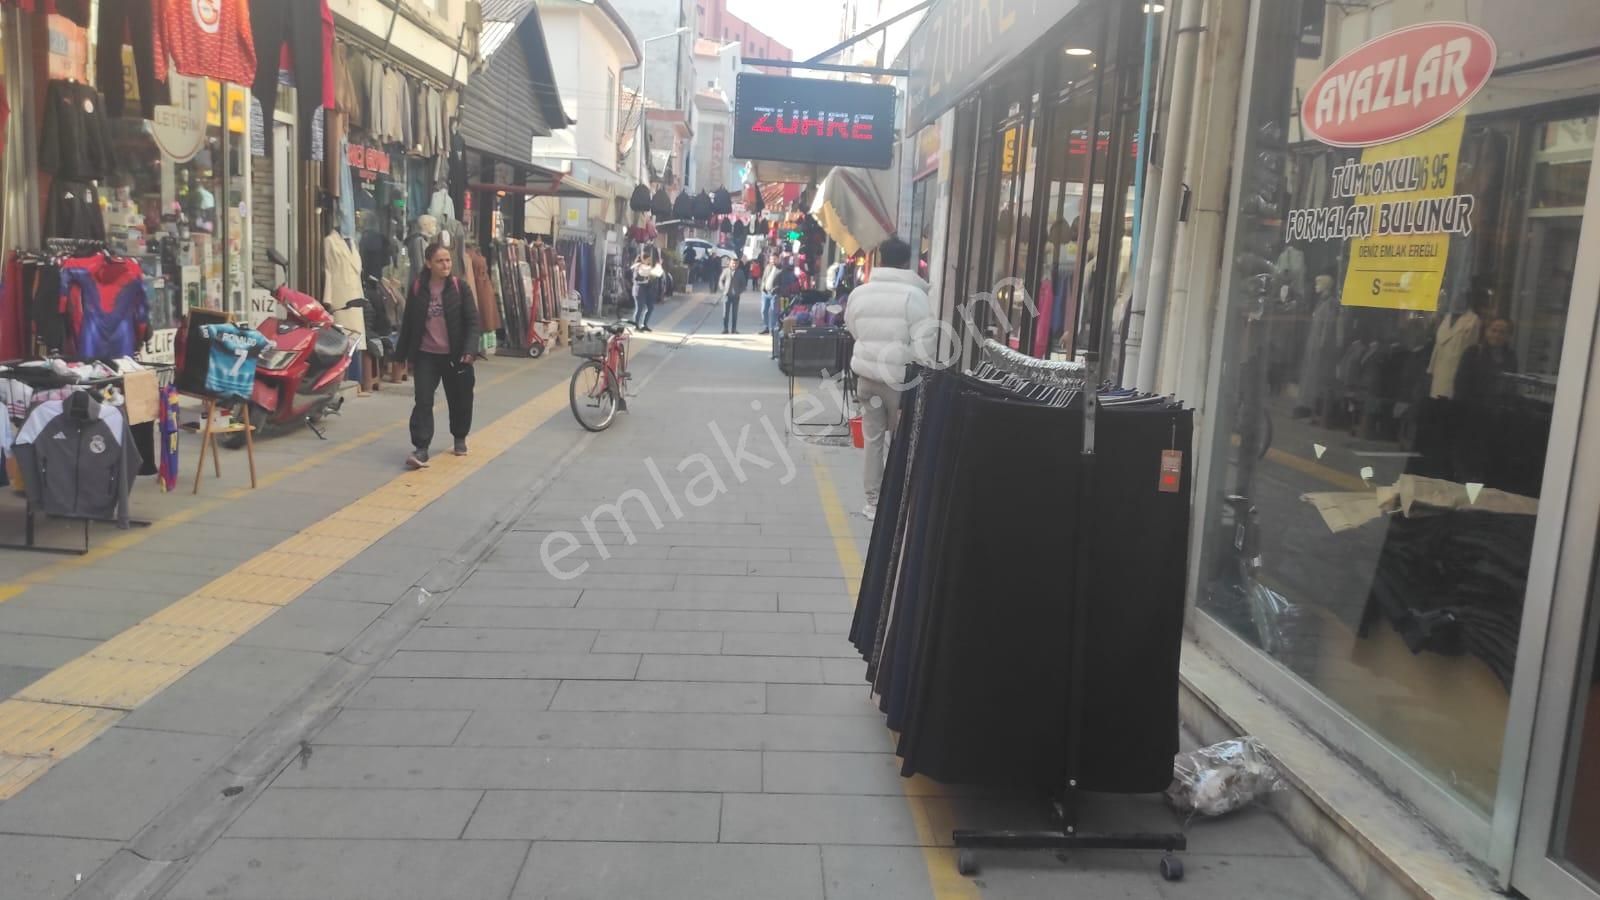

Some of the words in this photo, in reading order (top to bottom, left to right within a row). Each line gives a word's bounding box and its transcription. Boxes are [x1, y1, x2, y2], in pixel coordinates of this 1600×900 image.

[1315, 36, 1473, 130] AYAZLAR
[751, 100, 875, 140] ZÜHRE
[1331, 158, 1366, 198] TÜM
[1372, 154, 1419, 194] OKUL
[1431, 153, 1450, 189] 95
[1285, 204, 1374, 243] FORMALARI
[1378, 194, 1475, 237] BULUNUR
[1359, 245, 1379, 257] DENİZ
[1380, 244, 1407, 257] EMLAK
[230, 348, 248, 377] 7
